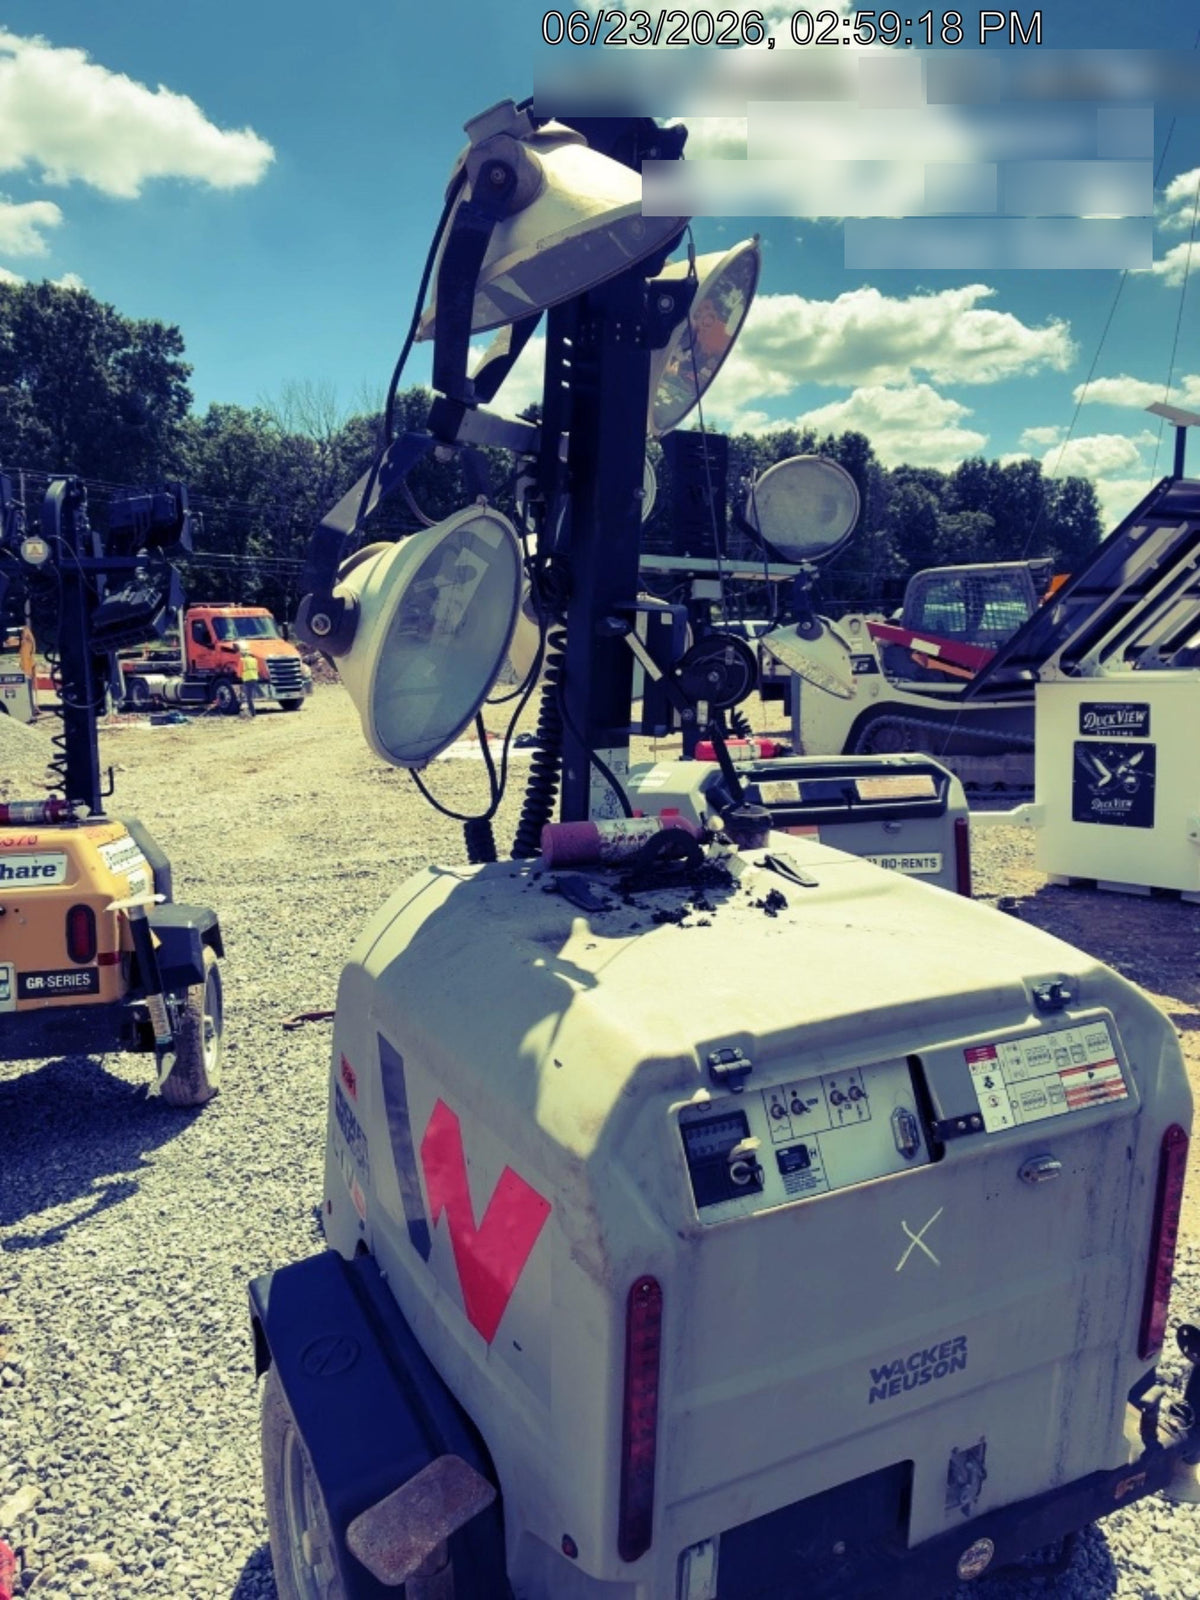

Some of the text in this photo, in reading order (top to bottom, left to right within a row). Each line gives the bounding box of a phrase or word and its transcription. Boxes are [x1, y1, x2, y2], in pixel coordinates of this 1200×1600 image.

[1116, 710, 1147, 724] VIEW
[868, 1352, 968, 1405] NEUSON
[869, 1334, 968, 1385] WACKER
